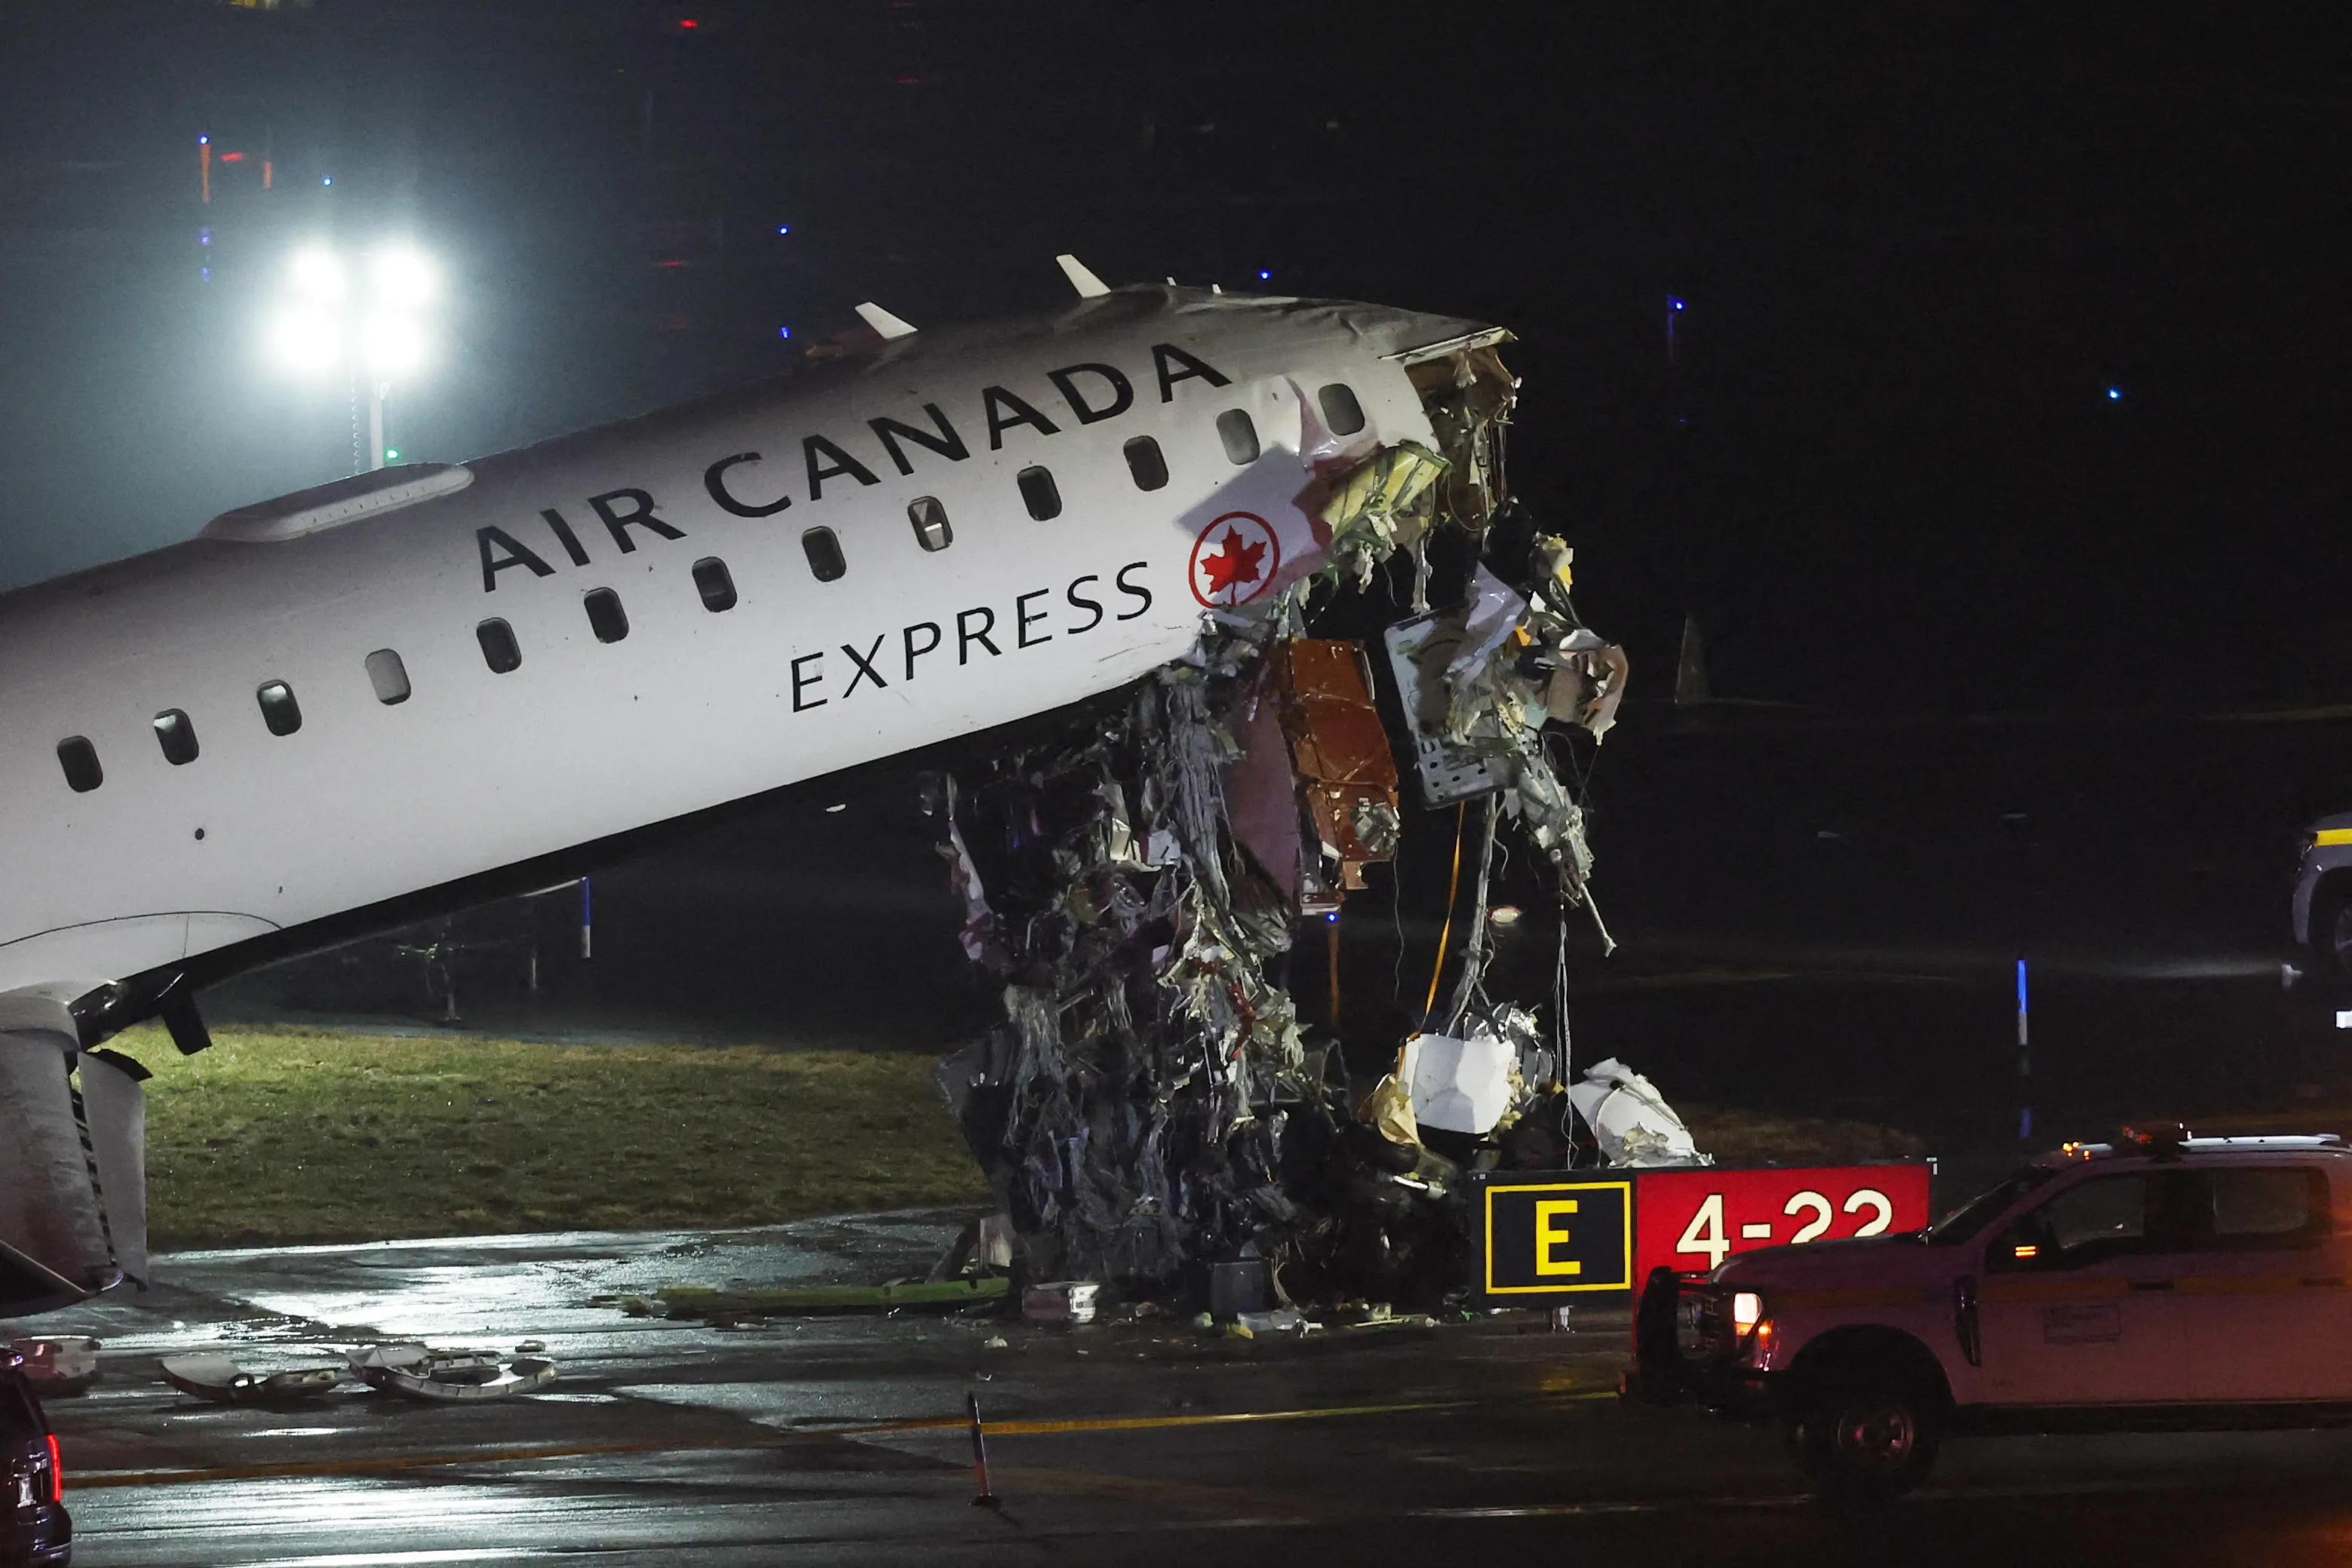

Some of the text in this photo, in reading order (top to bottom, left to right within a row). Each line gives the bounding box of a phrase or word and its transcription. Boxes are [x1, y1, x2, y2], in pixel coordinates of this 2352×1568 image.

[476, 343, 1232, 593] AIR CANADA
[791, 561, 1153, 713] EXPRESS
[1535, 1200, 1581, 1275] E
[1676, 1189, 1893, 1271] 4-22
